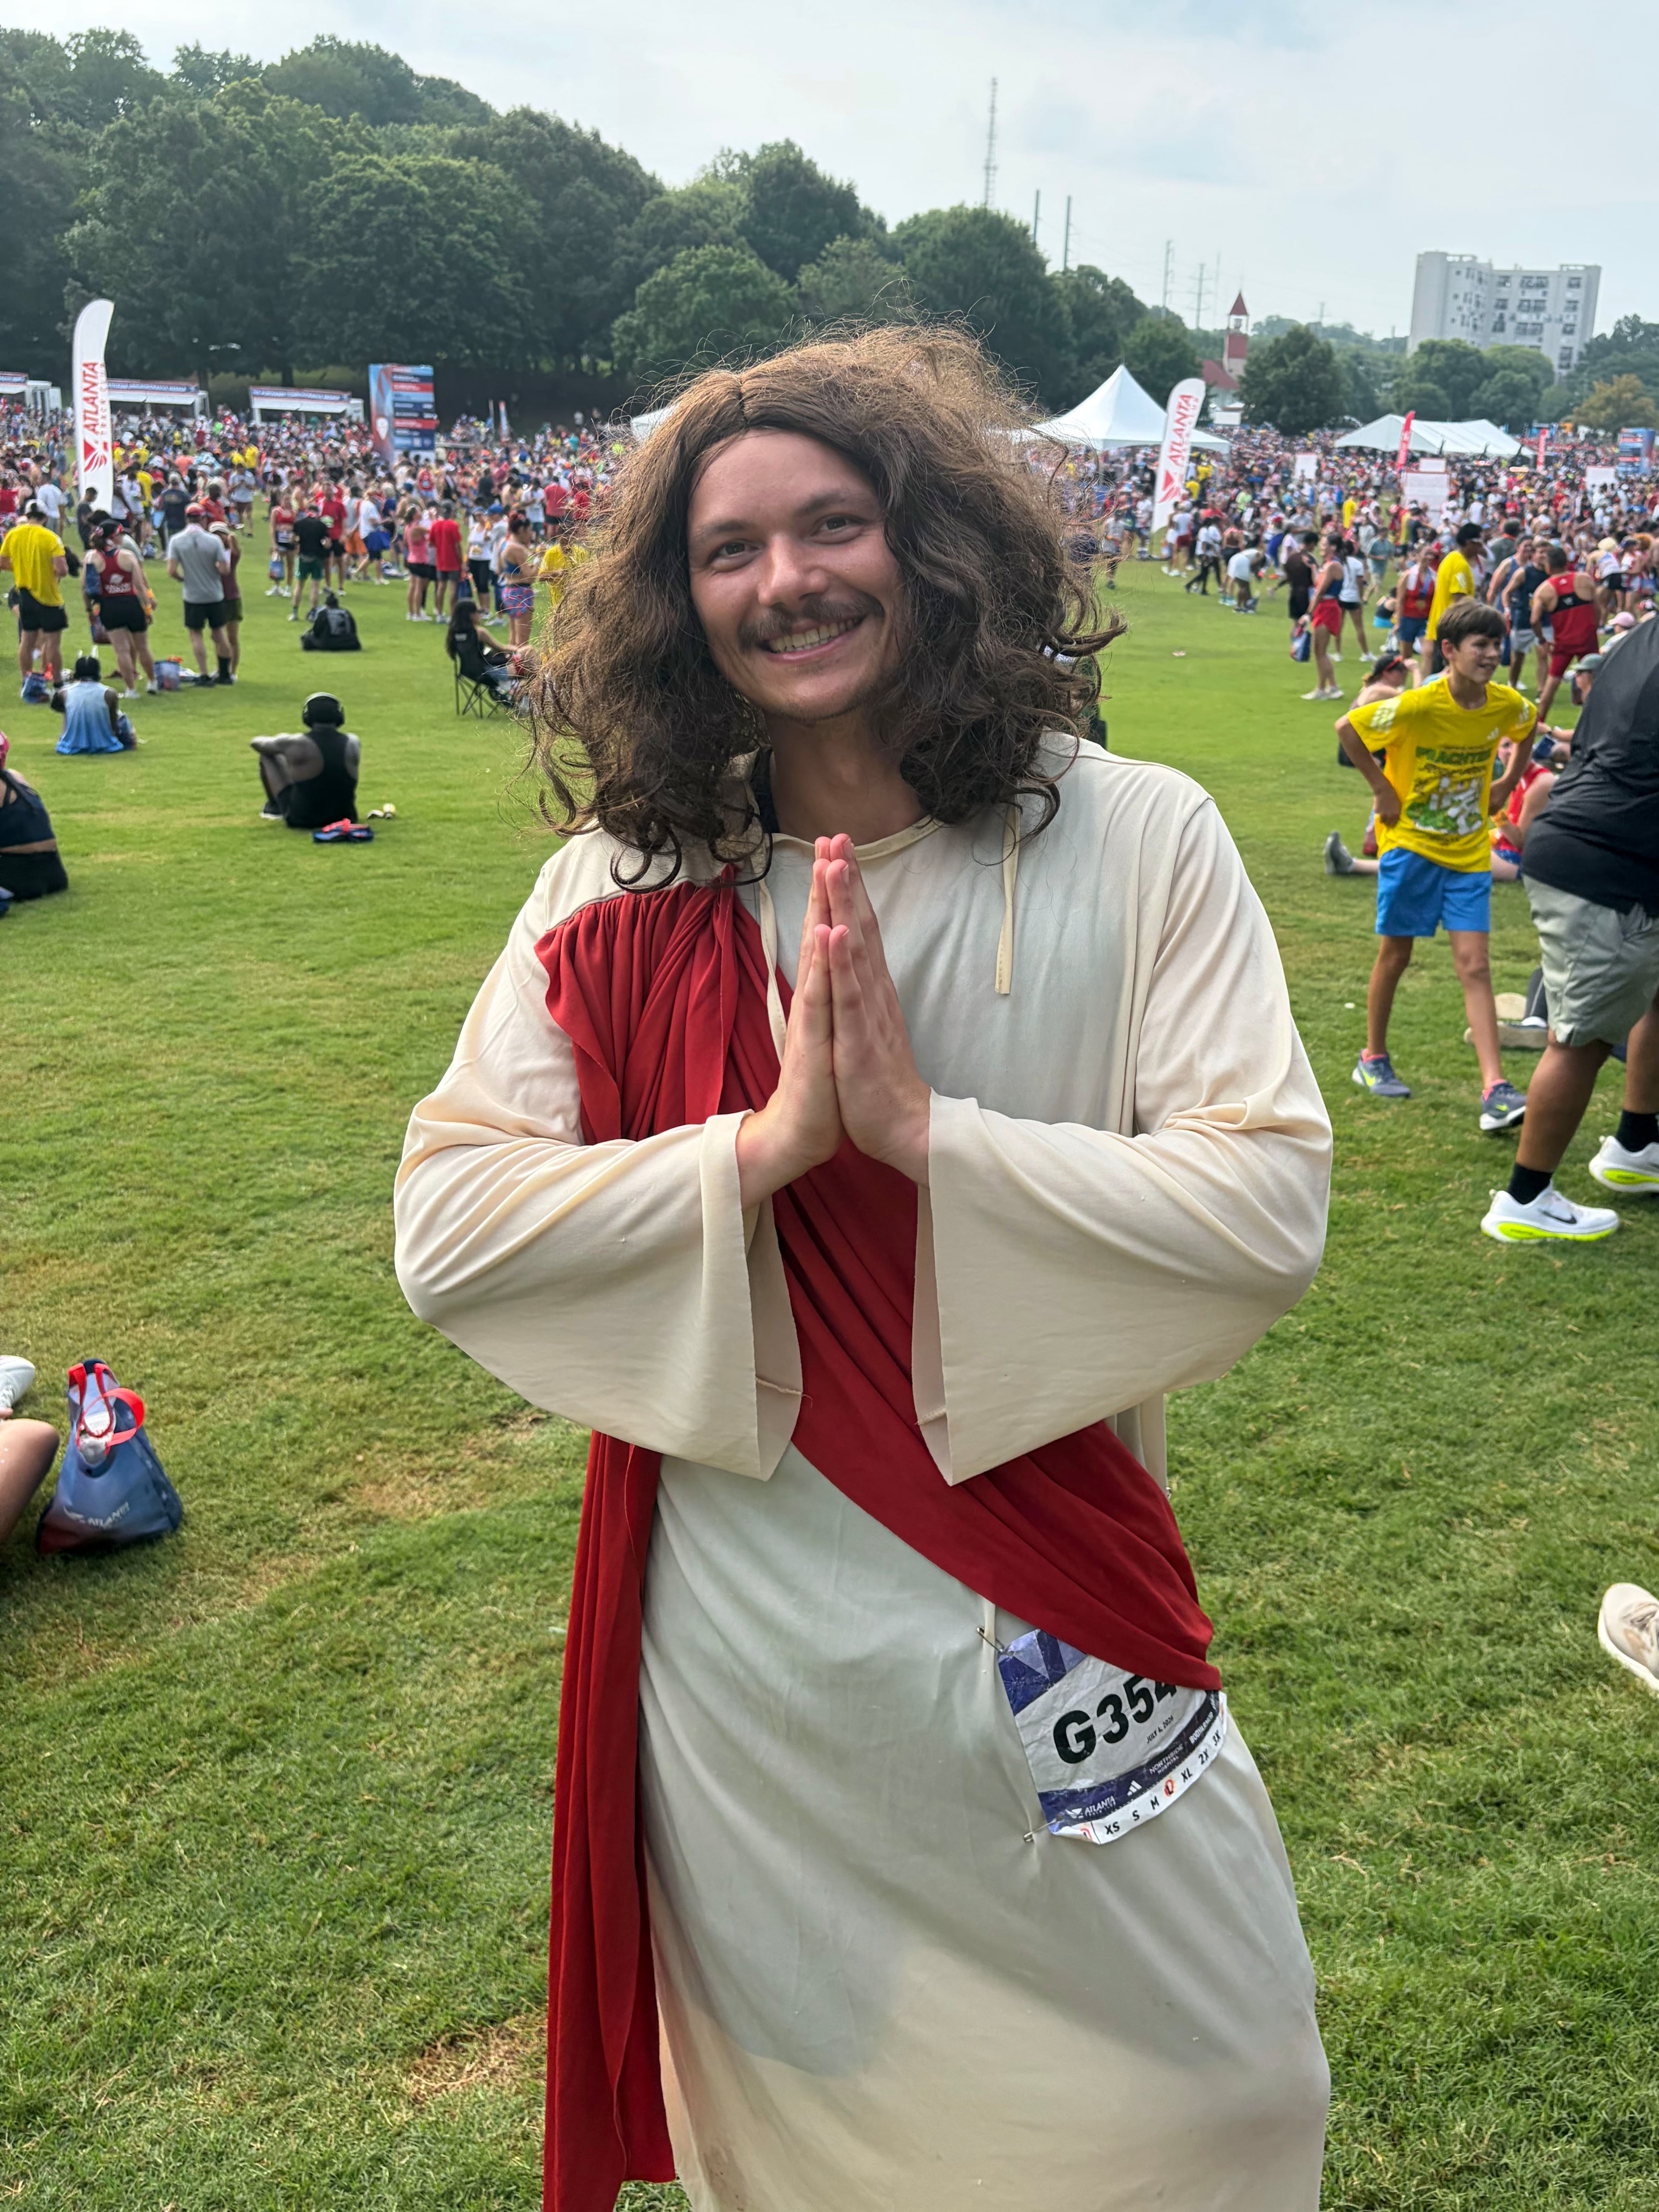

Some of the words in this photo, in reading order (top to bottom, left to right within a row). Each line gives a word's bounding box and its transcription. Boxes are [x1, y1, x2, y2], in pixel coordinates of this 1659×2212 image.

[82, 362, 98, 435] ATLANTA
[1168, 395, 1192, 466] ATLANTA
[1147, 1730, 1157, 1744] JULY
[1149, 1743, 1183, 1774] NORTHSIDE
[1157, 1755, 1179, 1774] HOSPITAL
[1104, 1821, 1120, 1834] XS
[1132, 1810, 1140, 1821] S
[1150, 1796, 1160, 1810] M
[1166, 1785, 1174, 1795] L
[1181, 1768, 1192, 1782] XL
[1198, 1749, 1209, 1765] 2X
[1212, 1730, 1221, 1746] 3X
[1085, 1796, 1116, 1817] ATLANTA
